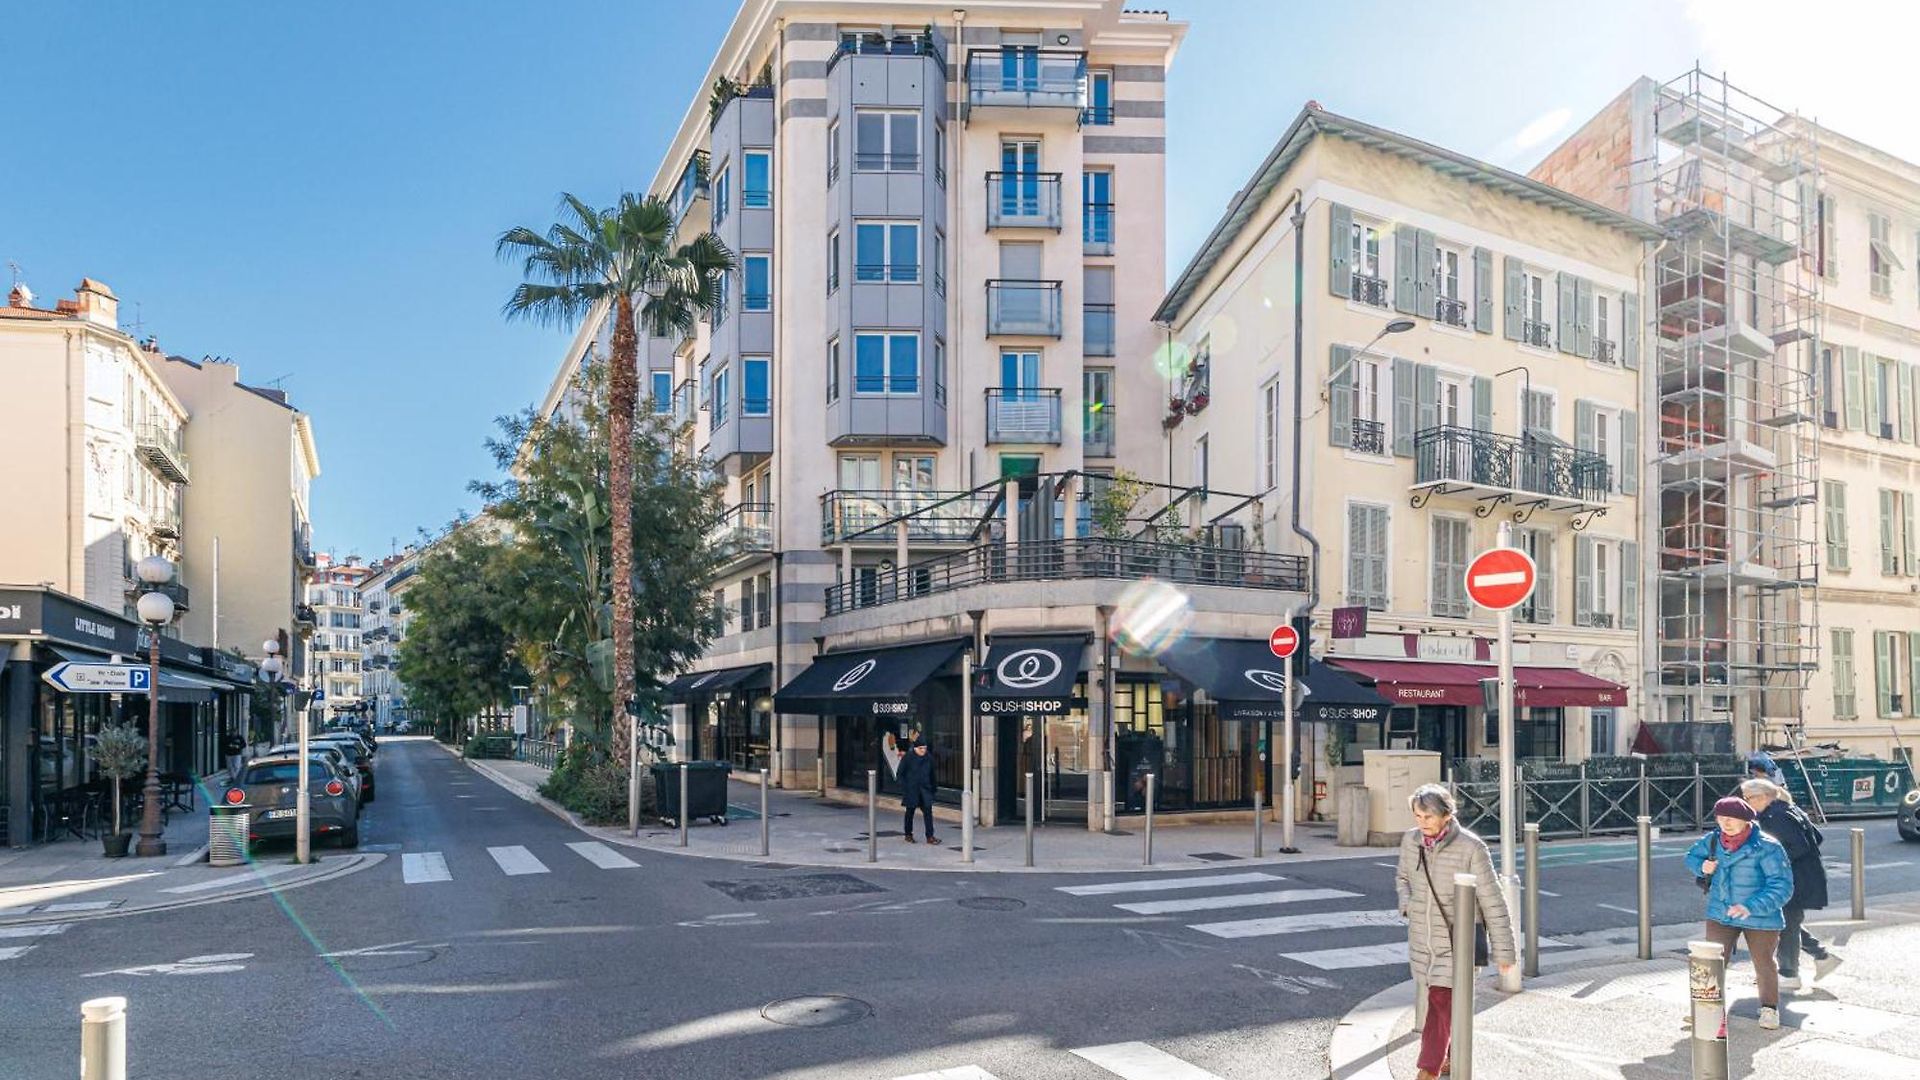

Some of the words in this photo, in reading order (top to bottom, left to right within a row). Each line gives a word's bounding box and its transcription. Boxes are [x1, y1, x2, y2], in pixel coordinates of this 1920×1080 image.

[134, 671, 144, 687] P
[1398, 688, 1445, 699] RESTAURANT
[992, 700, 1061, 713] SUSHISHOP
